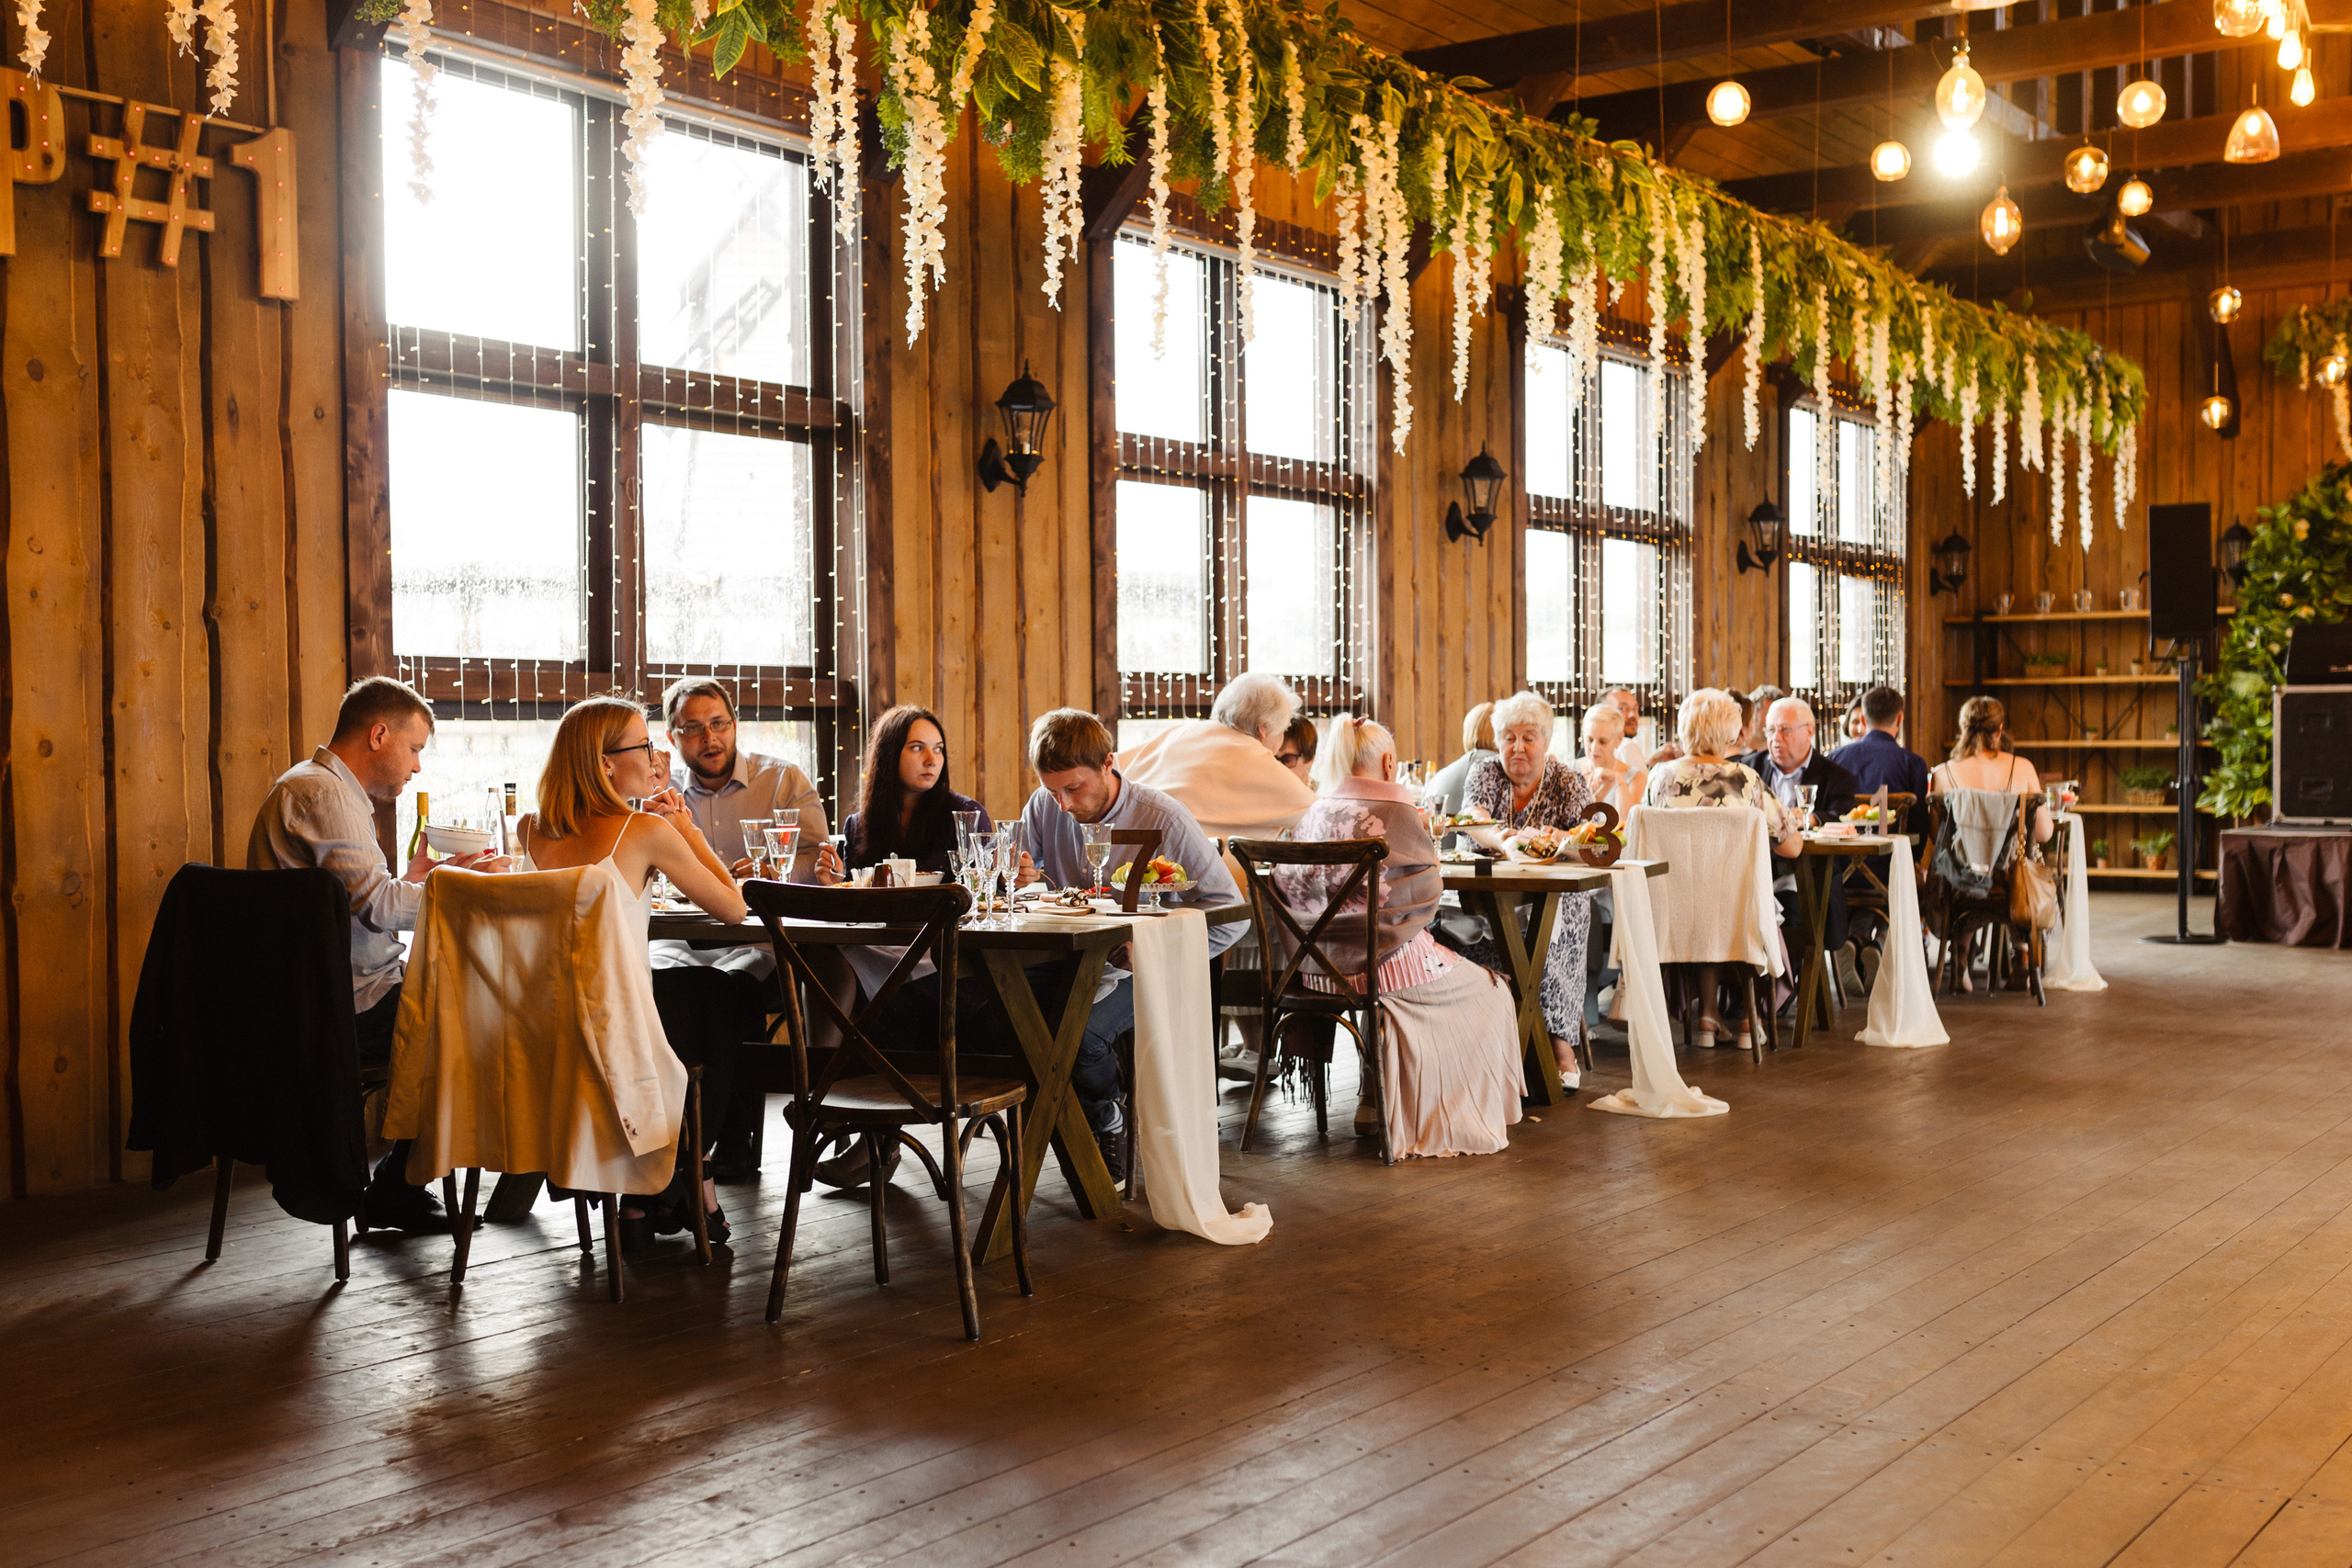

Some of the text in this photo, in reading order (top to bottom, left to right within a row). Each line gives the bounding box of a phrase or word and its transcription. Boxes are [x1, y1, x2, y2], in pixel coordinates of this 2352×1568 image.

[1578, 802, 1622, 867] 3
[1870, 784, 1888, 836] 1
[1111, 829, 1162, 912] 7
